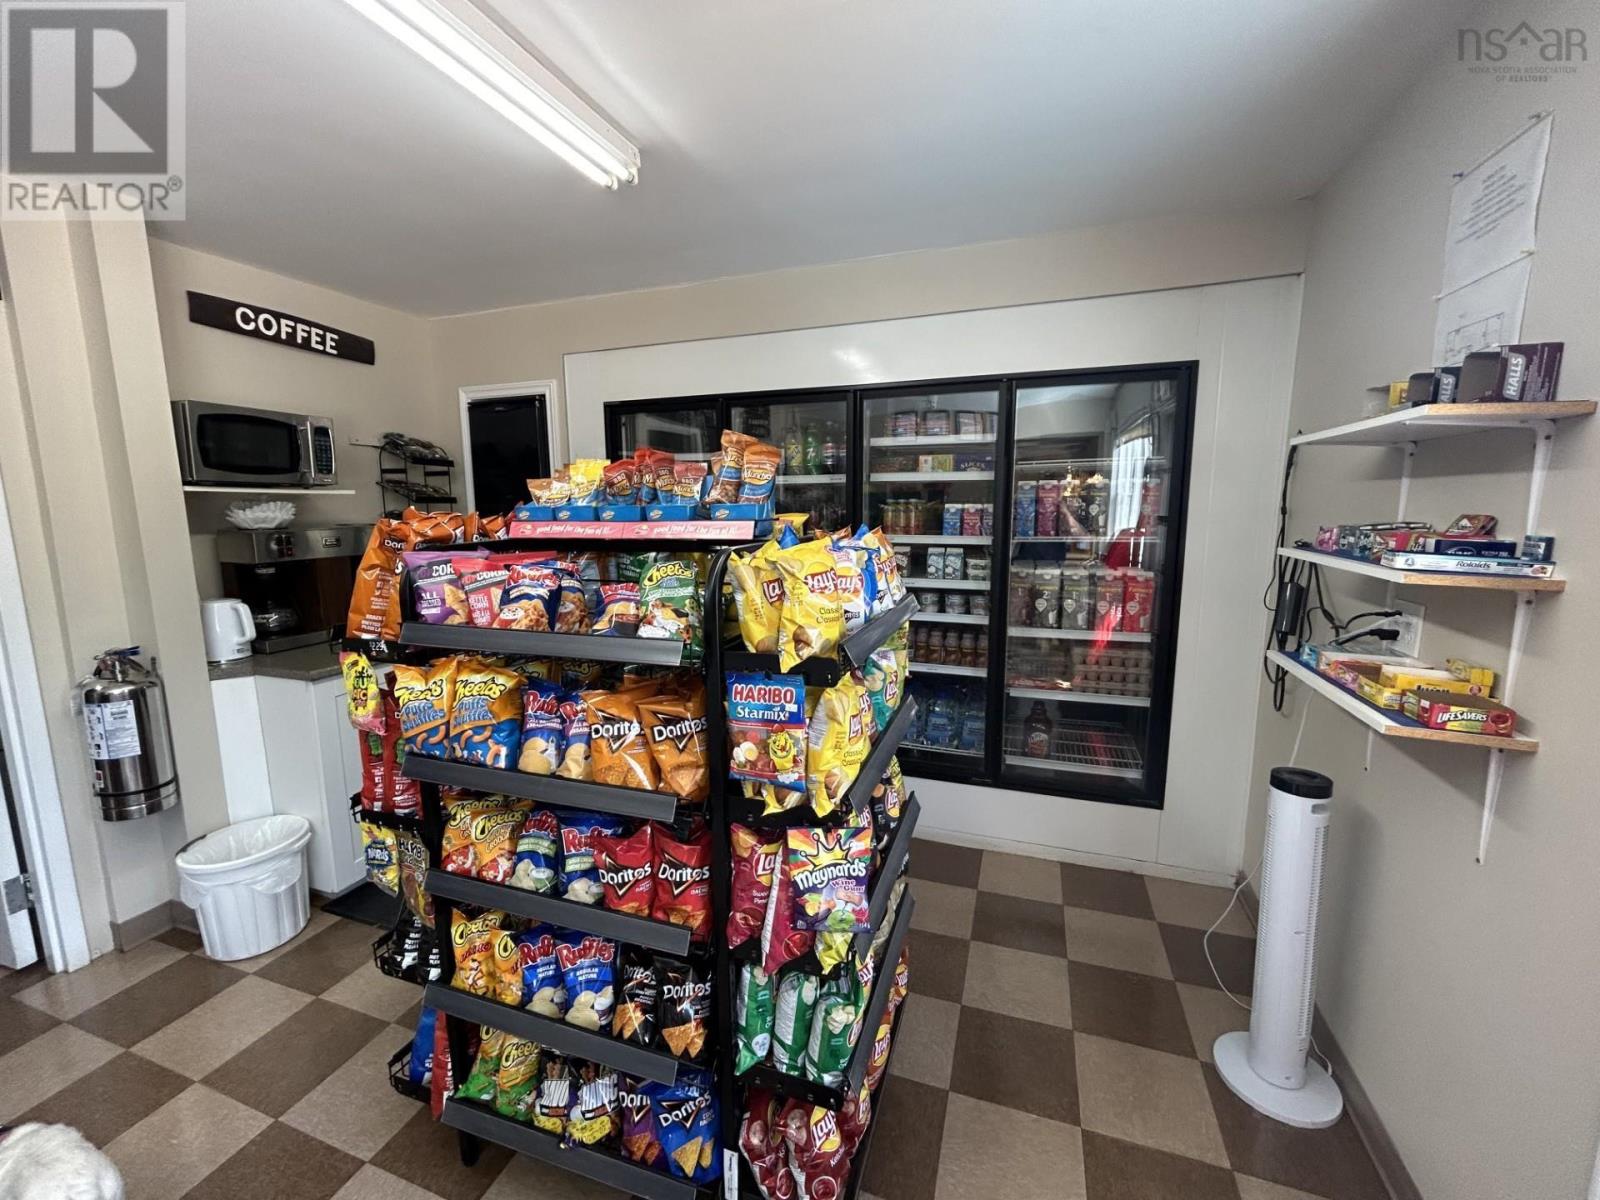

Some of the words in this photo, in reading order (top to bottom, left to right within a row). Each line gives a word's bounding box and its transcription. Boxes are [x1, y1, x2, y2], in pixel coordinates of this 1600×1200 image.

[235, 307, 339, 355] COFFEE
[1505, 357, 1523, 396] HALLS
[1440, 377, 1454, 403] ALLS
[641, 561, 695, 588] Cheetos
[1456, 560, 1493, 569] Rolaids
[837, 575, 863, 594] ay's
[453, 677, 506, 711] heetos
[732, 683, 795, 705] HARIBO
[736, 705, 786, 721] Starmix
[653, 717, 708, 743] Doritos
[474, 809, 525, 841] Cheetos
[599, 861, 652, 885] Doritos
[658, 864, 710, 882] Doritos
[794, 858, 866, 891] Maynards
[831, 877, 856, 888] Wine
[555, 936, 615, 971] Ruffles
[663, 982, 712, 1000] Doritos
[619, 1092, 650, 1108] Dori
[658, 1090, 712, 1128] Doritos
